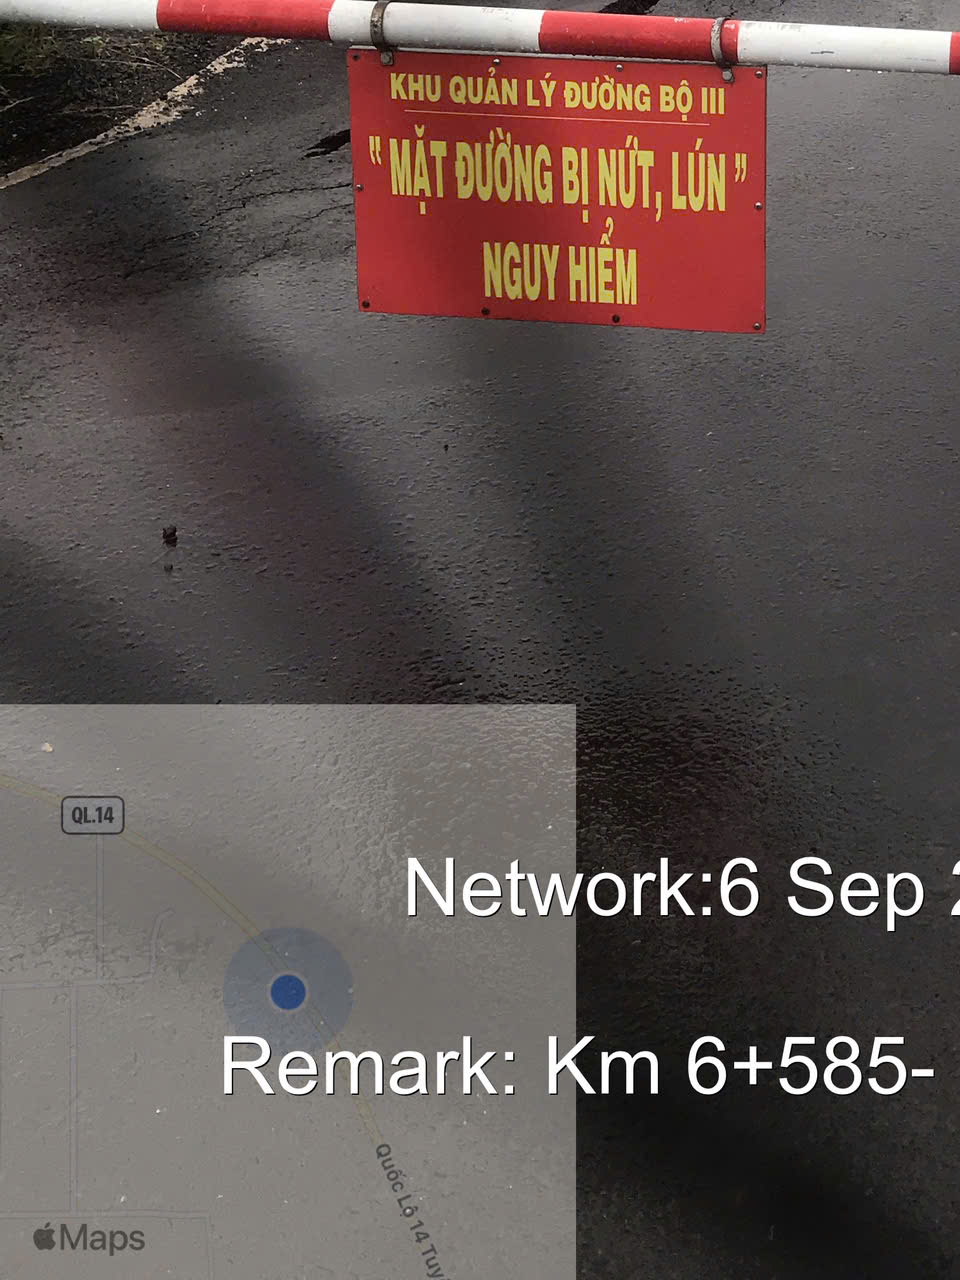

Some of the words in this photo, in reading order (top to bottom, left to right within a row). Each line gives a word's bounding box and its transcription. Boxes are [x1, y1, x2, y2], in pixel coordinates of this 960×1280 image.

[390, 72, 441, 102] KHU
[449, 66, 518, 106] QUẢN
[526, 72, 557, 108] LÝ
[563, 75, 652, 113] ĐƯỜNG
[659, 79, 694, 122] BỘ
[701, 87, 726, 115] III
[455, 127, 554, 205] ĐƯỜNG
[561, 146, 590, 224] BỊ
[597, 134, 663, 223] NỨT,
[482, 240, 561, 302] NGUY
[568, 216, 639, 306] HIỂM
